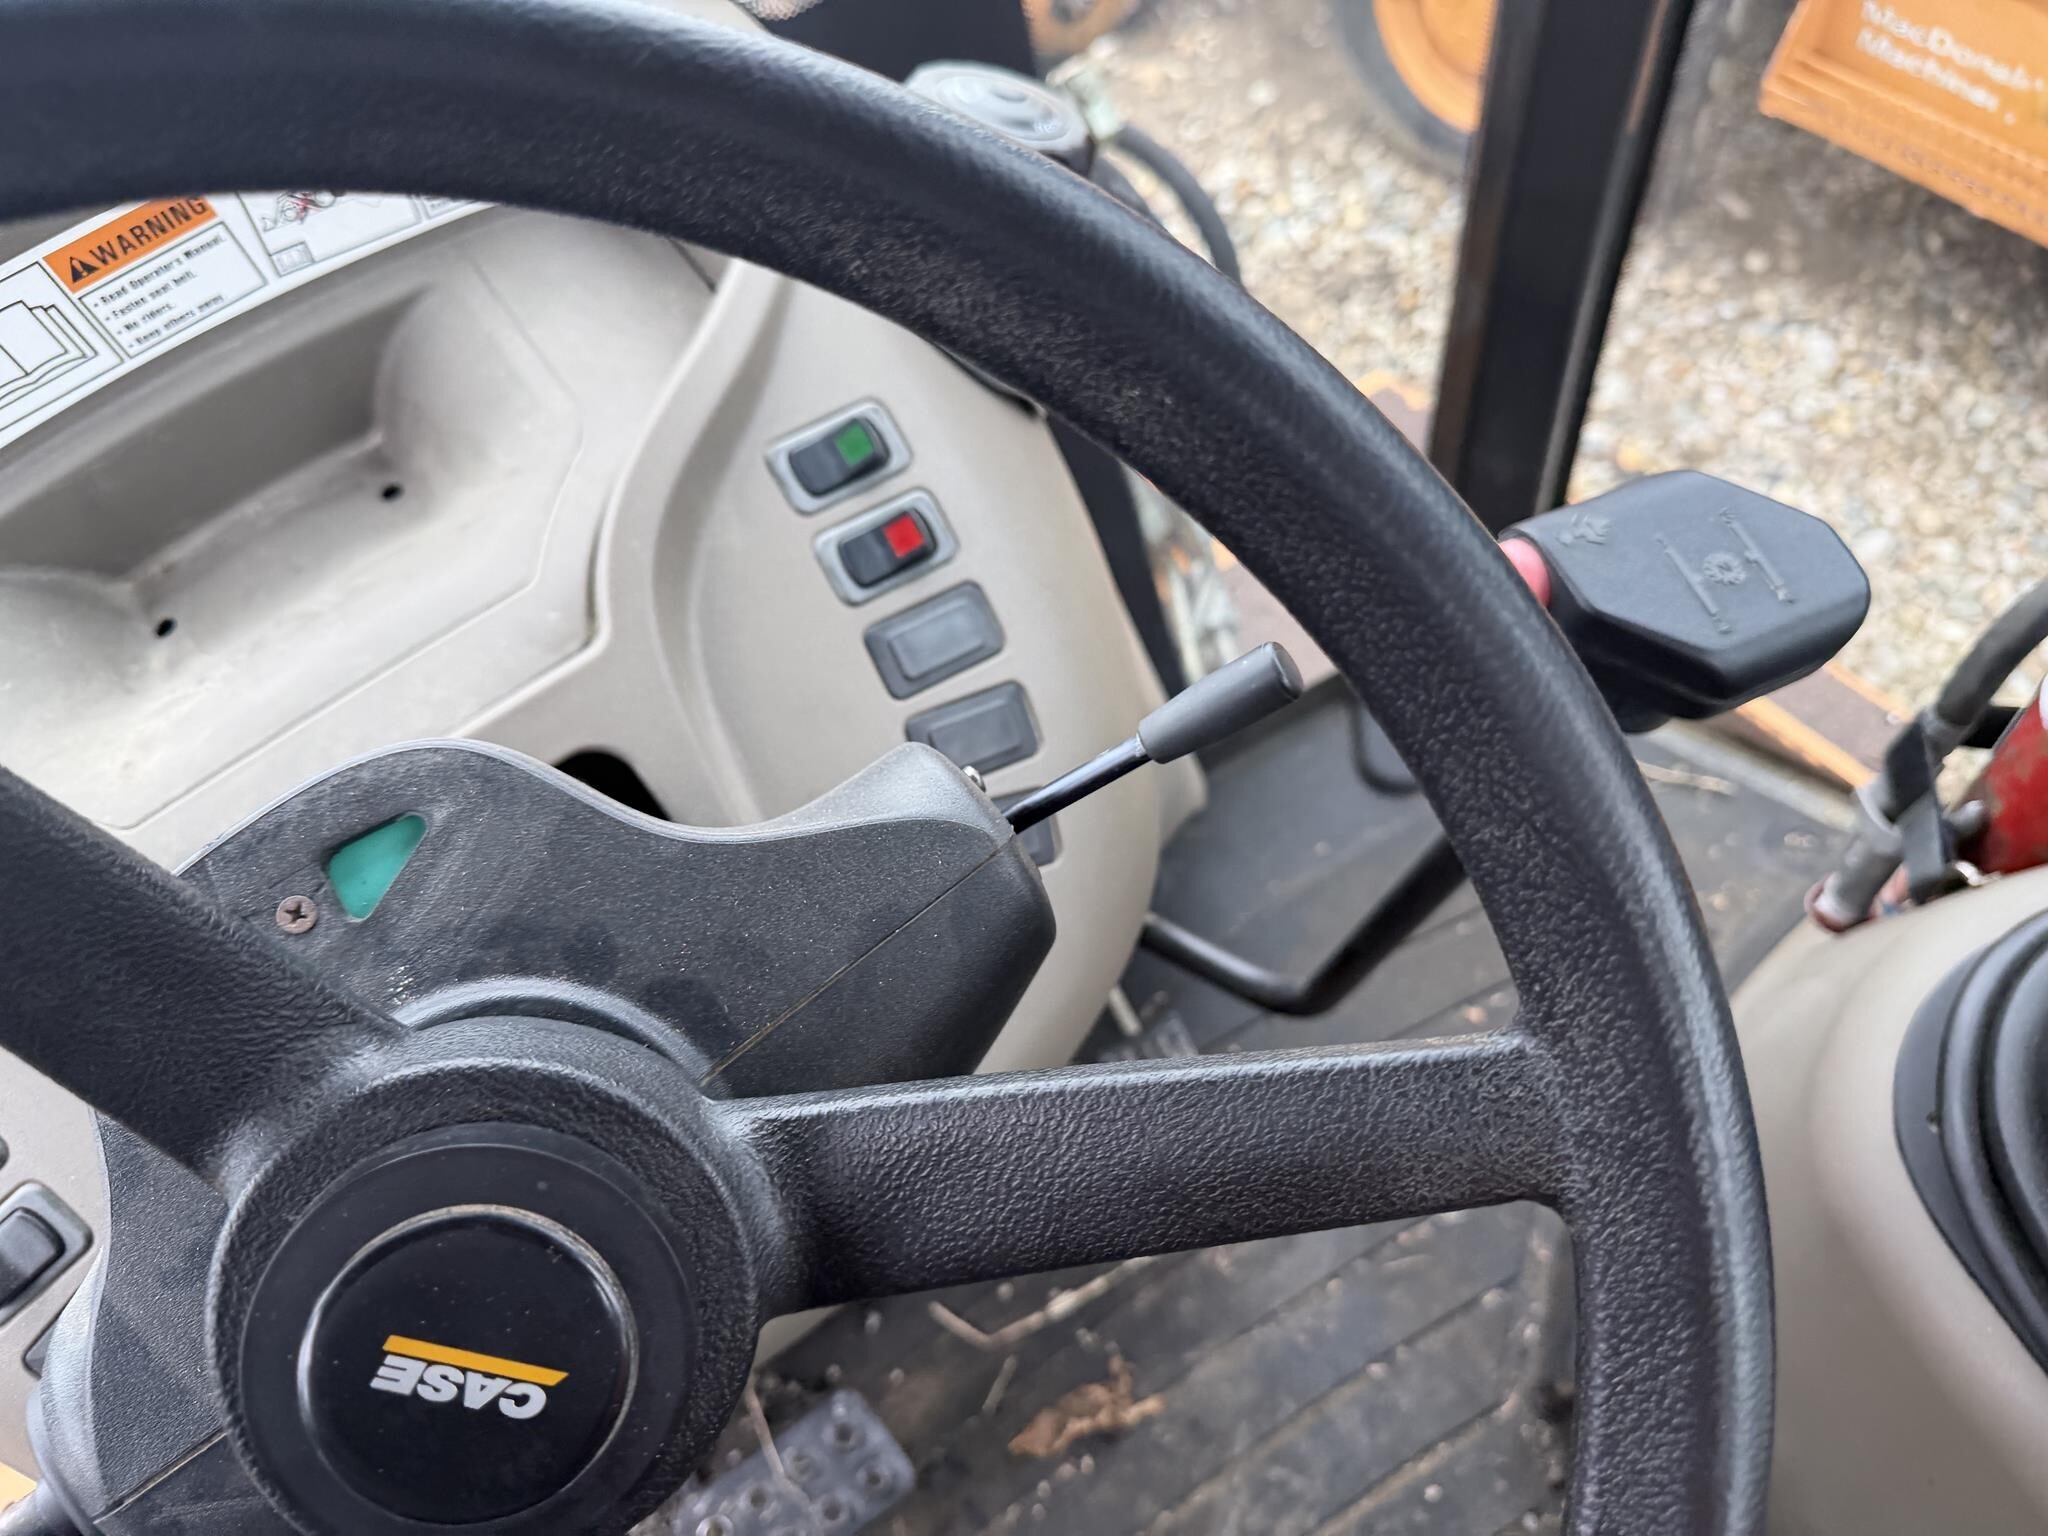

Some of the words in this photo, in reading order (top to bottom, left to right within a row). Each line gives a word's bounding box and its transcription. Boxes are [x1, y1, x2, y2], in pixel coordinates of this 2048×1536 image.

[89, 196, 209, 266] WARNING
[100, 285, 129, 304] Read
[148, 281, 173, 300] seat
[370, 1354, 547, 1419] CASE
